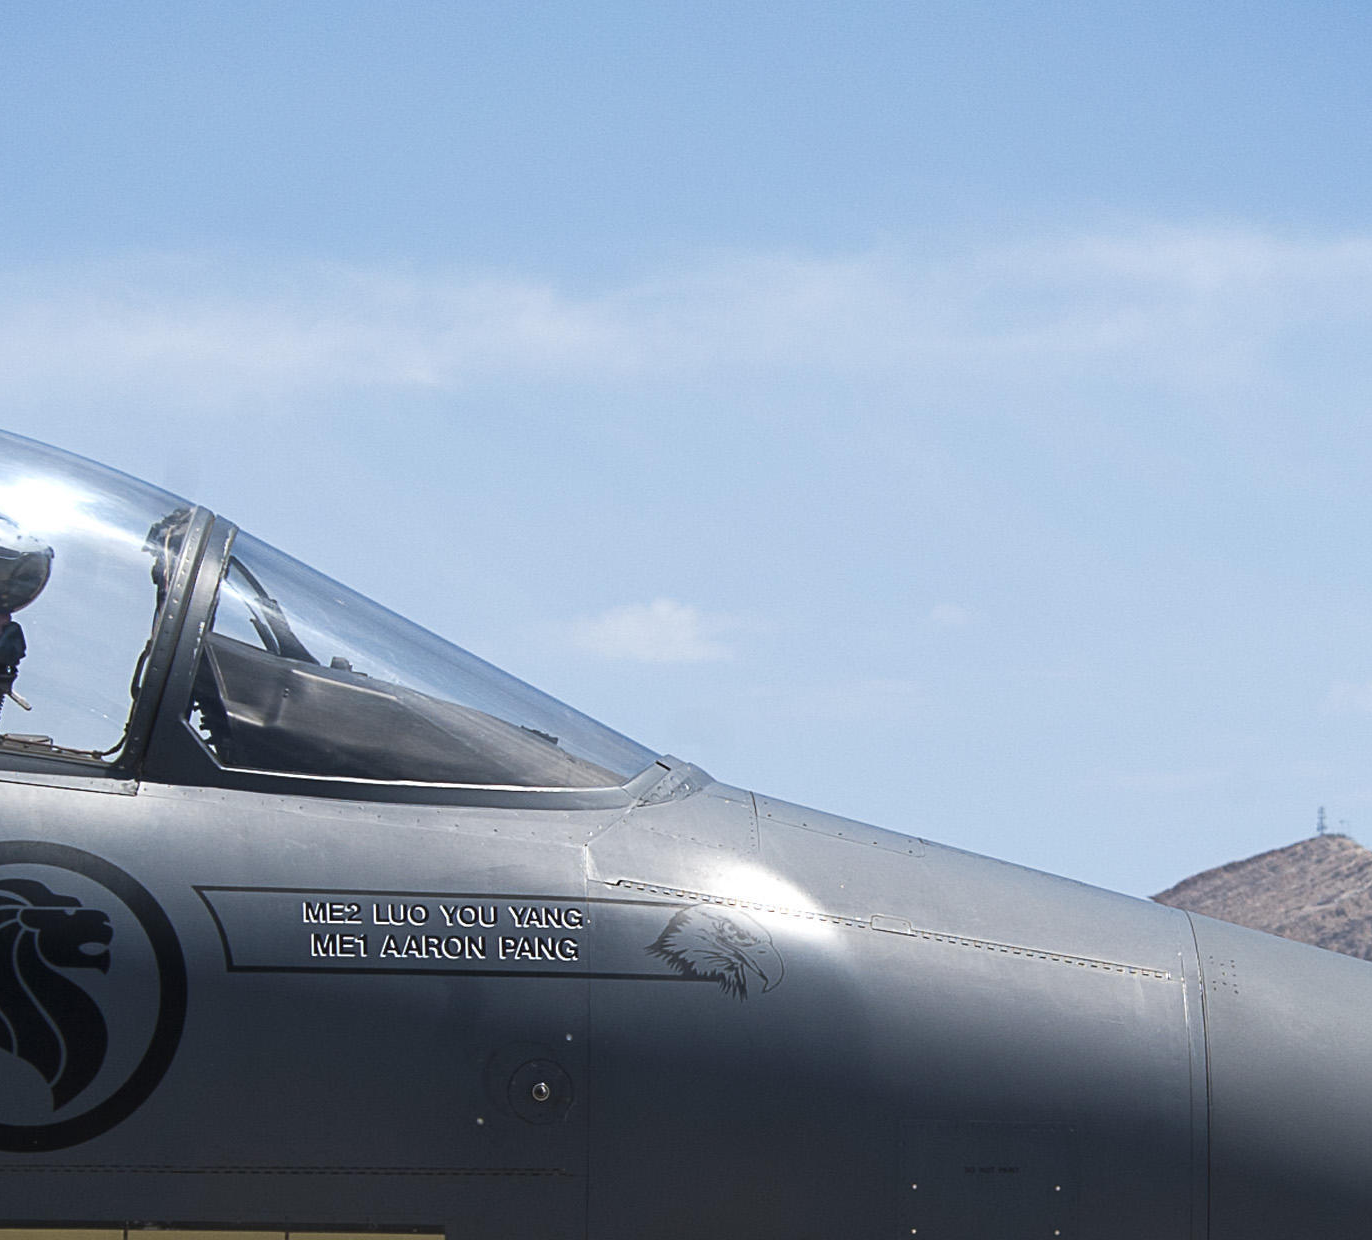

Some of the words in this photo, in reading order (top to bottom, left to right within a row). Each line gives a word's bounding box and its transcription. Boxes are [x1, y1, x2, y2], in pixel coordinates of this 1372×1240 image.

[301, 901, 362, 925] ME2
[372, 903, 428, 926] LUO
[437, 904, 499, 929] YOU
[507, 906, 584, 931] YANG
[309, 932, 370, 958] ME1
[379, 934, 487, 960] AARON
[497, 936, 579, 961] PANG
